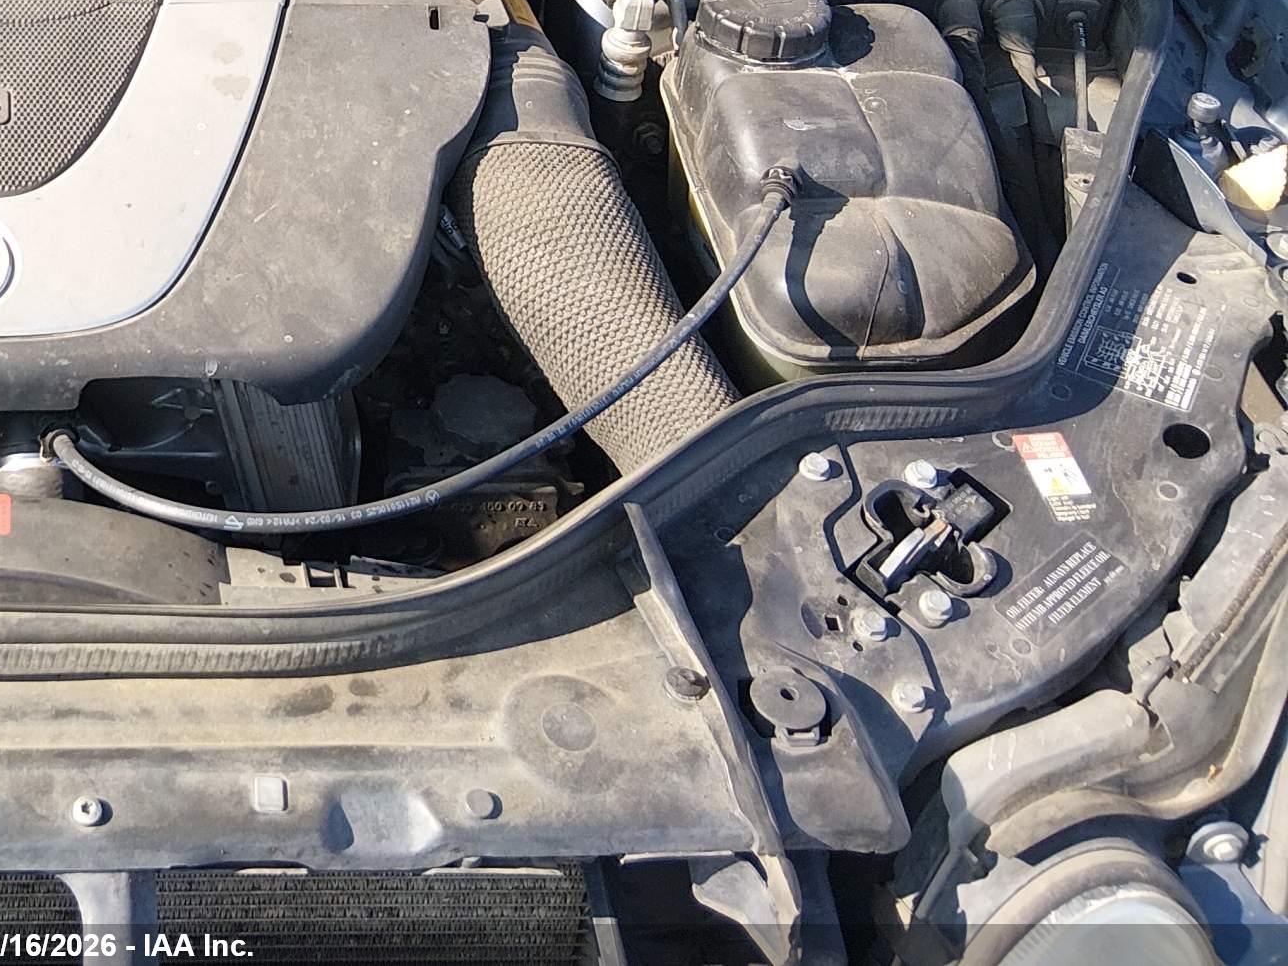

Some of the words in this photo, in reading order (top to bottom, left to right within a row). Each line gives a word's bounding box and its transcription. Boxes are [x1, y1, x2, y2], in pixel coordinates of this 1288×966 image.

[1005, 603, 1022, 619] OIL
[1041, 562, 1070, 589] ALWAYS
[1065, 541, 1097, 569] REPLACE
[1013, 611, 1037, 631] WITH
[1031, 602, 1047, 617] MB
[1042, 577, 1077, 609] APPROVED
[1072, 558, 1099, 583] FLEECE
[1094, 549, 1111, 565] OIL
[1047, 600, 1074, 624] FILTER
[1069, 576, 1102, 606] ELEMENT
